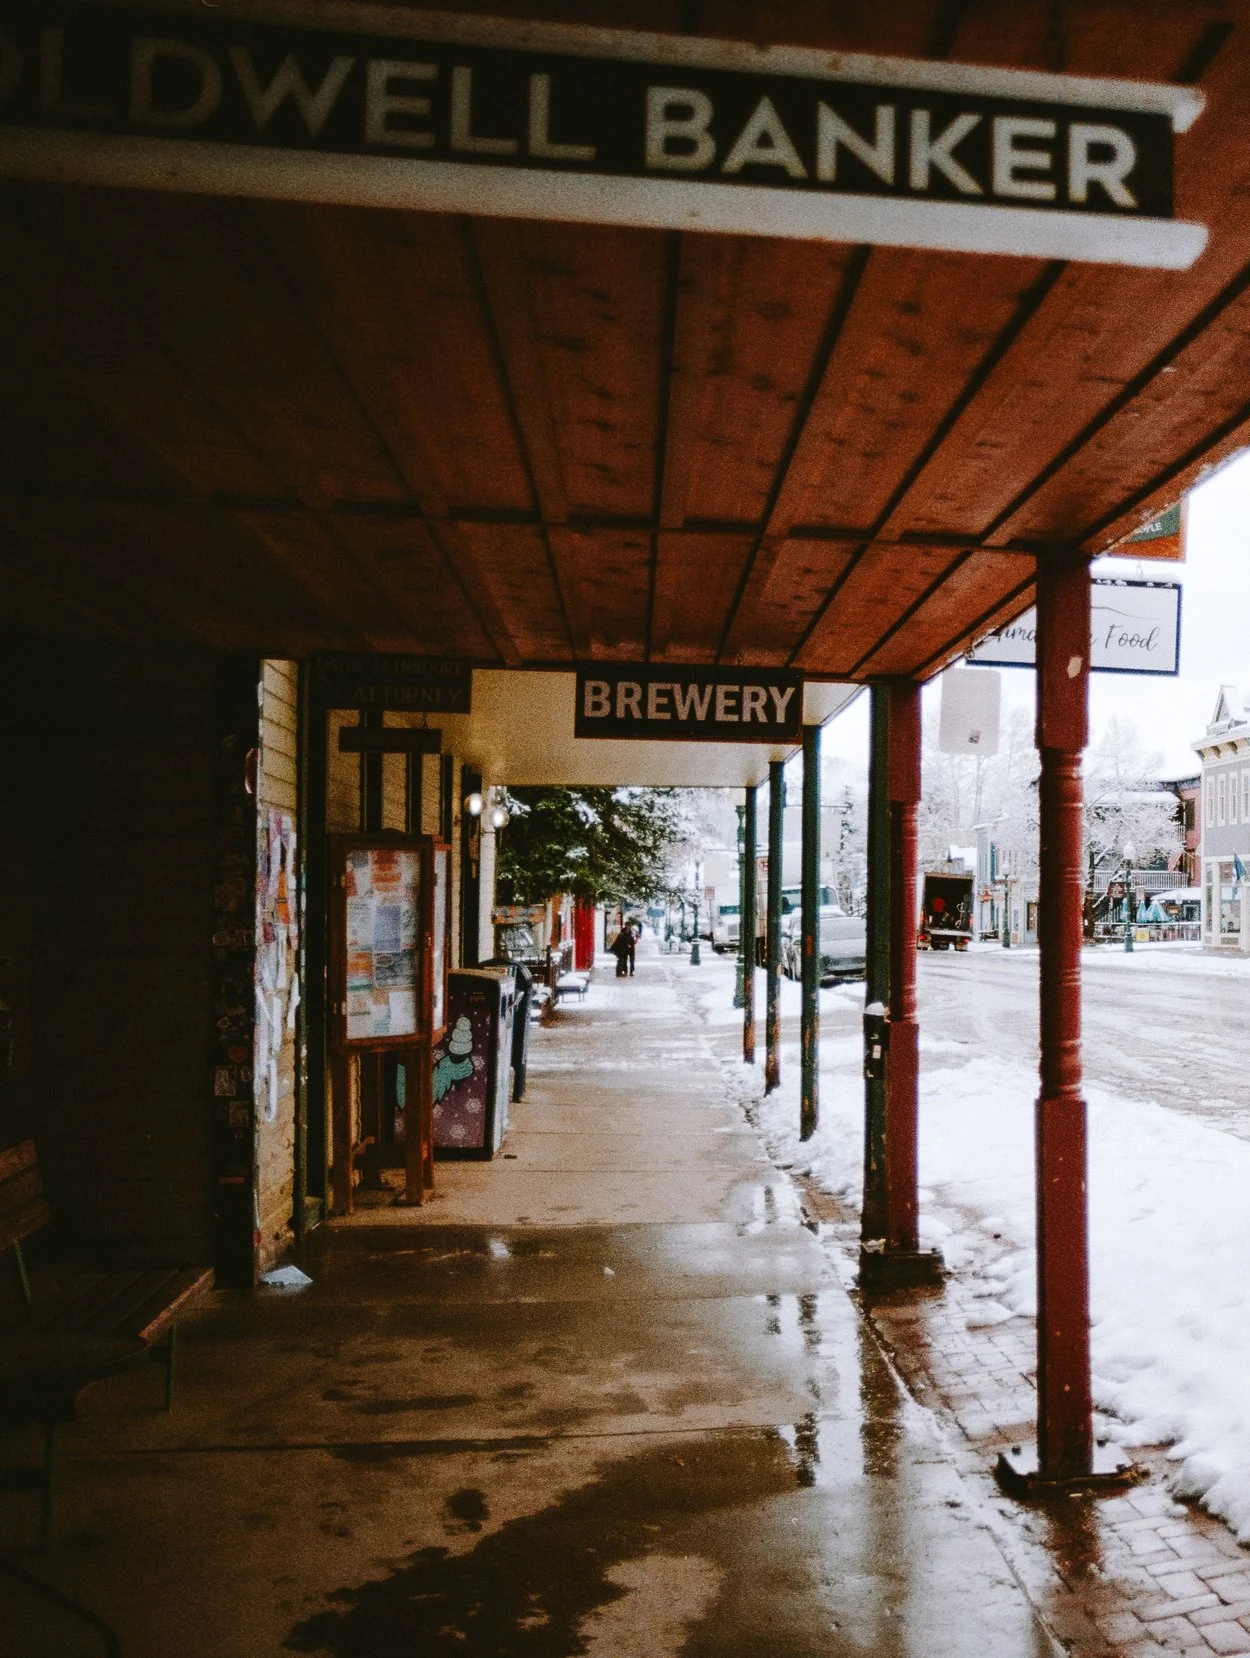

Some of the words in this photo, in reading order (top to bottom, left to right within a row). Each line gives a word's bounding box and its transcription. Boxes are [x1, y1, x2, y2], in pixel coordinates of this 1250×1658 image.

[645, 86, 1138, 209] BANKER
[1105, 624, 1161, 651] Food
[352, 685, 463, 705] ATTORNEY
[583, 680, 796, 723] BREWERY
